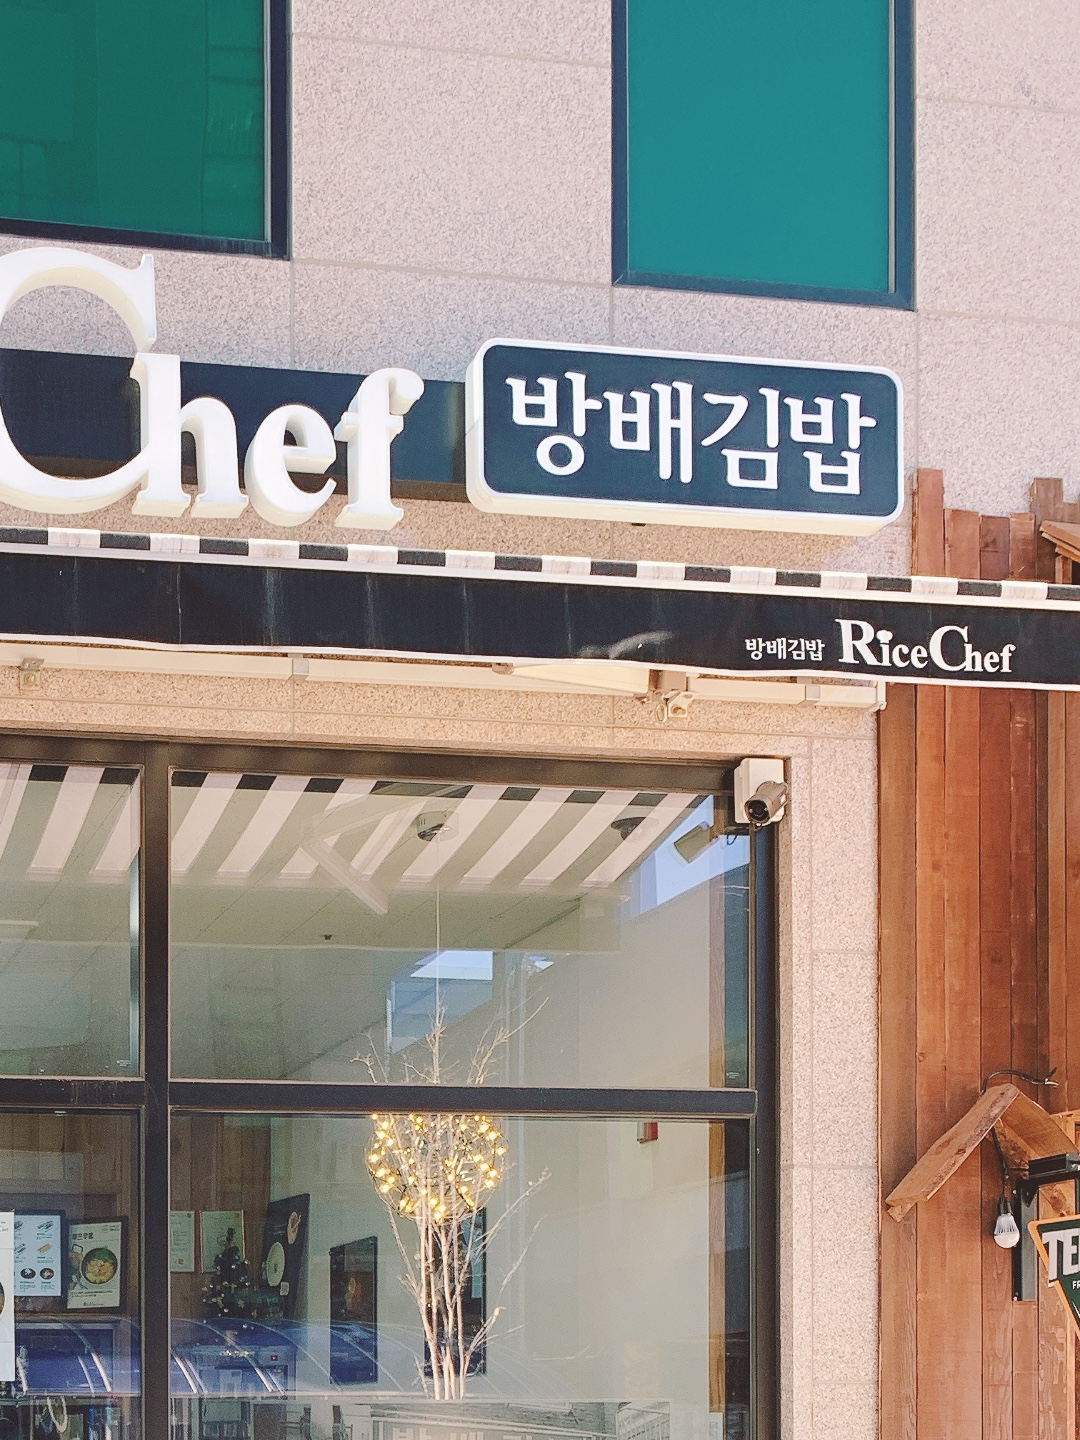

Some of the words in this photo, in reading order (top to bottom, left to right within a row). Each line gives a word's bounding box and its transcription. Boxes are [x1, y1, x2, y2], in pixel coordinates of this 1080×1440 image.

[505, 371, 877, 498] 방배김밥
[745, 637, 825, 662] 방배김밥
[835, 618, 1016, 673] RiceChef
